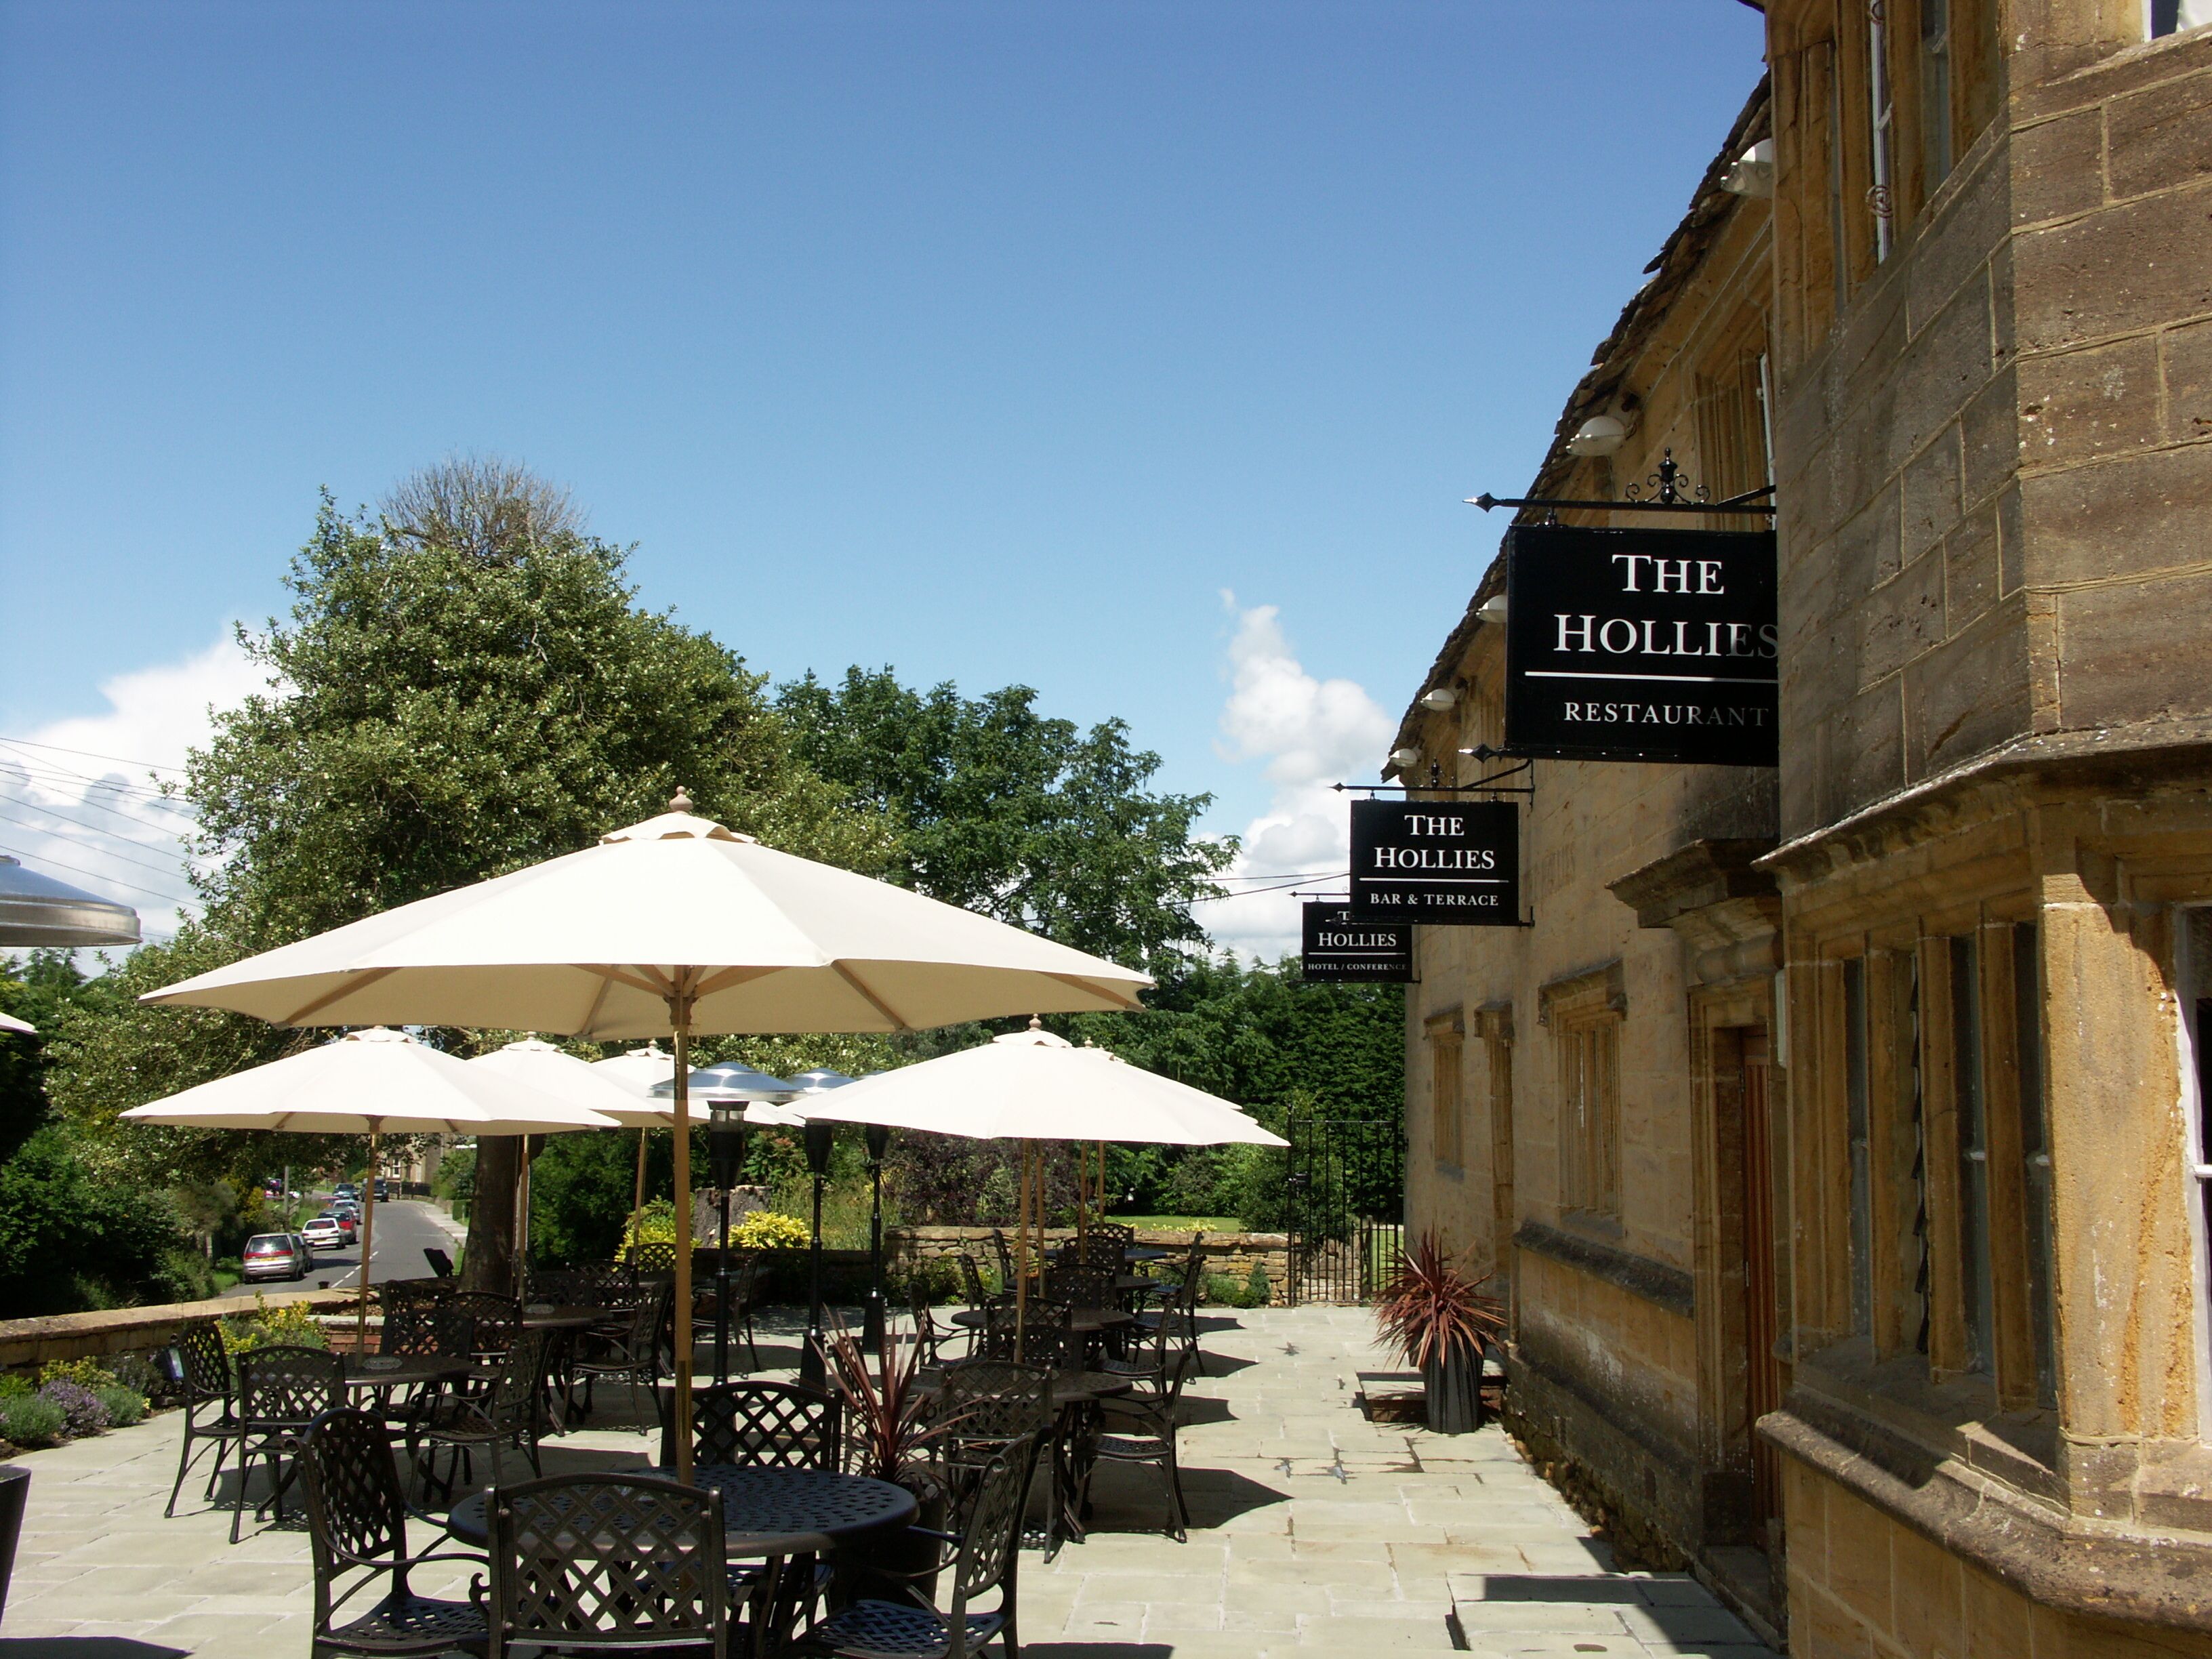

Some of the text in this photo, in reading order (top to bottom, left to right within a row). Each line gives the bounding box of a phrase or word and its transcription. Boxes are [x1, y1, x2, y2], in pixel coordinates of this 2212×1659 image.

[1612, 554, 1725, 594] THE
[1553, 613, 1778, 659] HOLLIES
[1564, 701, 1769, 726] RESTAURANT
[1404, 815, 1465, 836] THE
[1374, 846, 1495, 869] HOLLIES
[1370, 893, 1498, 906] BAR & TERRACE
[1317, 932, 1397, 947] HOLLIES
